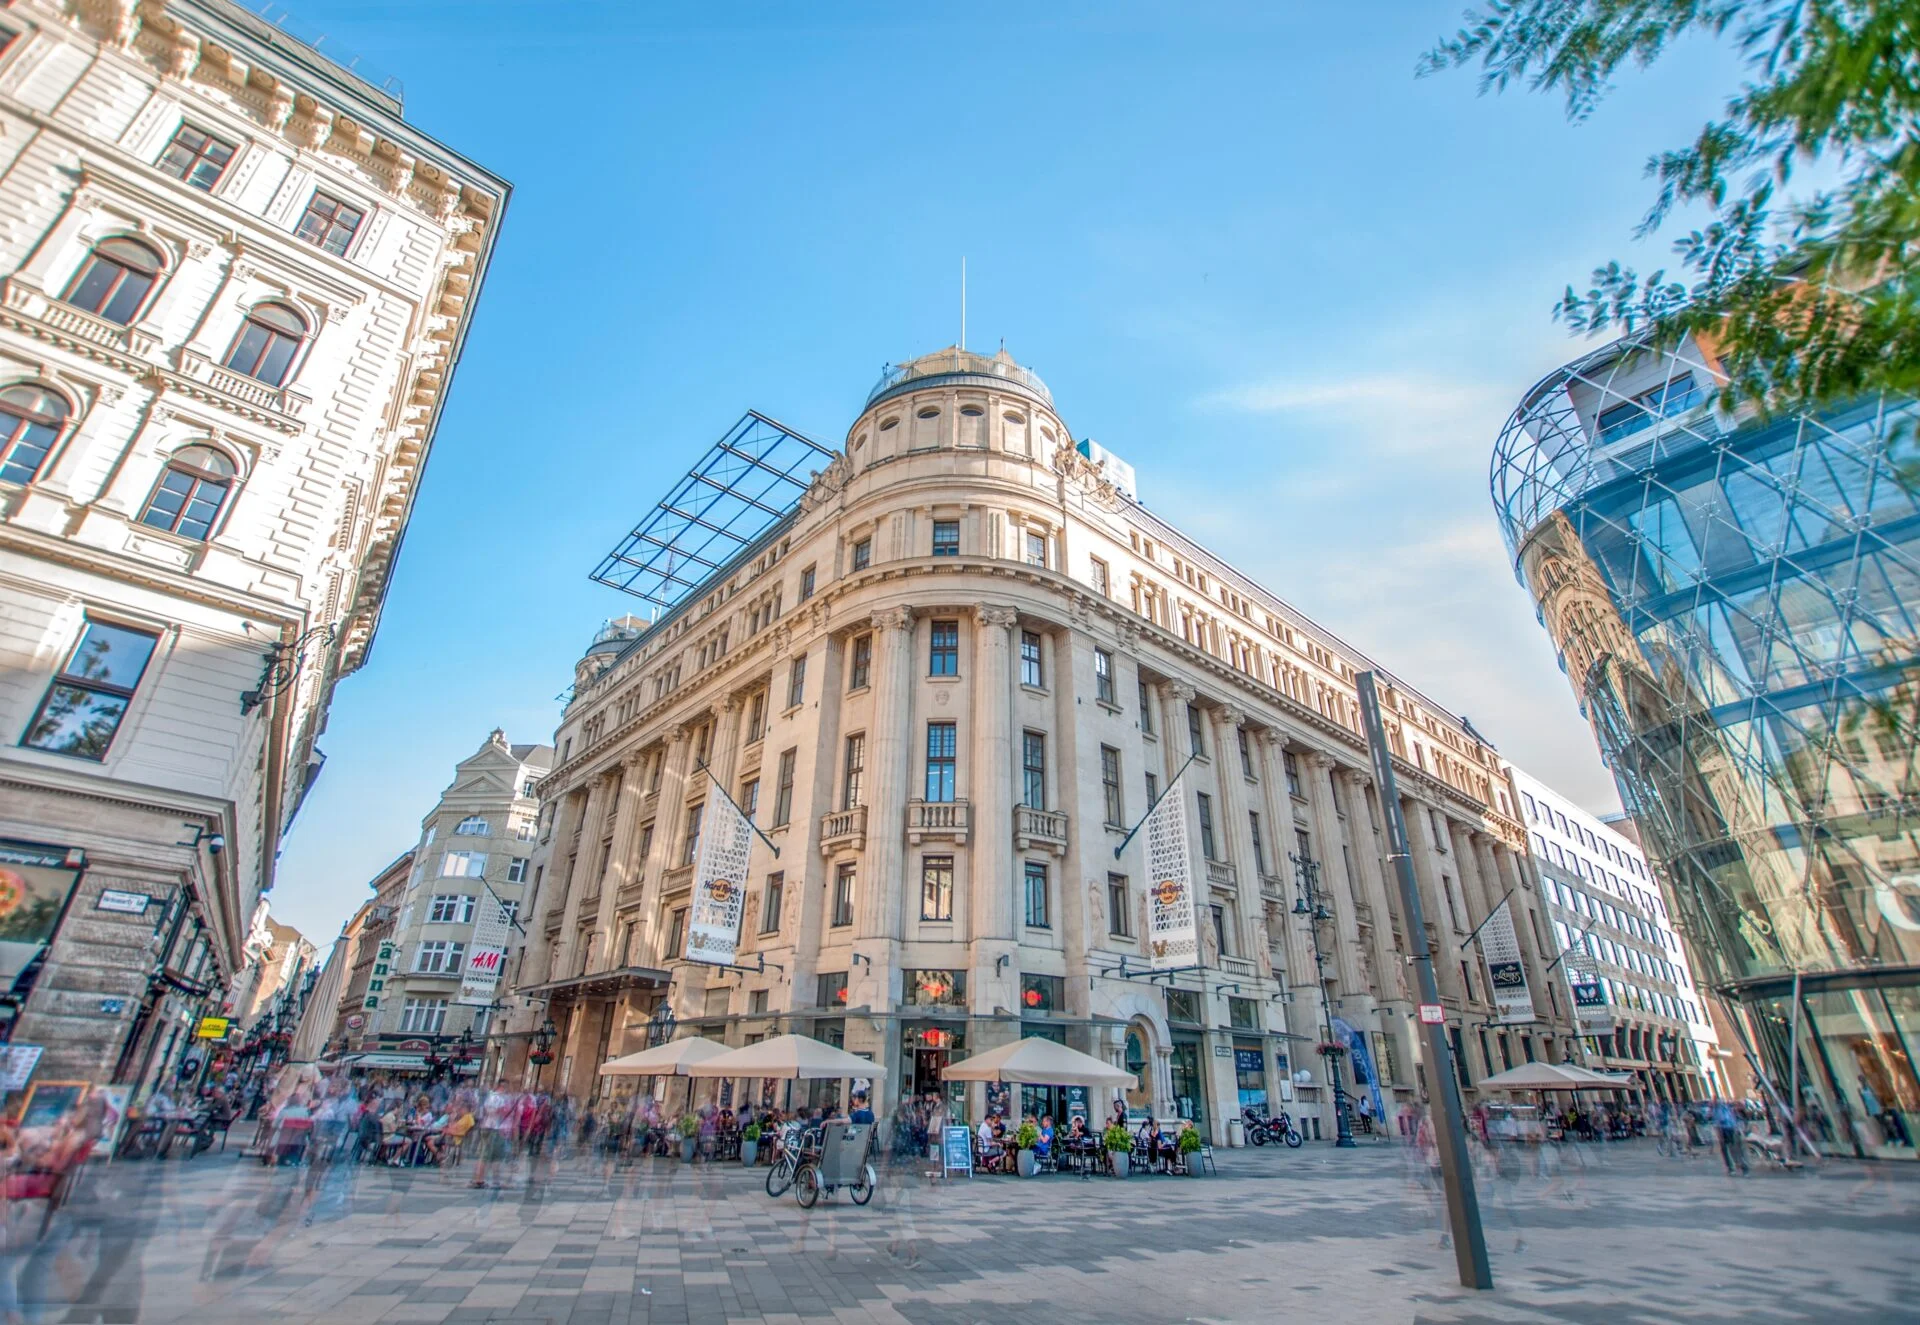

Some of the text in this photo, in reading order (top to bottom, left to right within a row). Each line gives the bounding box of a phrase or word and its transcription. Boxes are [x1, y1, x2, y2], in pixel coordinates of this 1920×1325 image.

[704, 879, 741, 897] Hard Rock
[1151, 882, 1184, 896] Hard Rock
[471, 951, 499, 970] H&M
[365, 947, 392, 1008] anna
